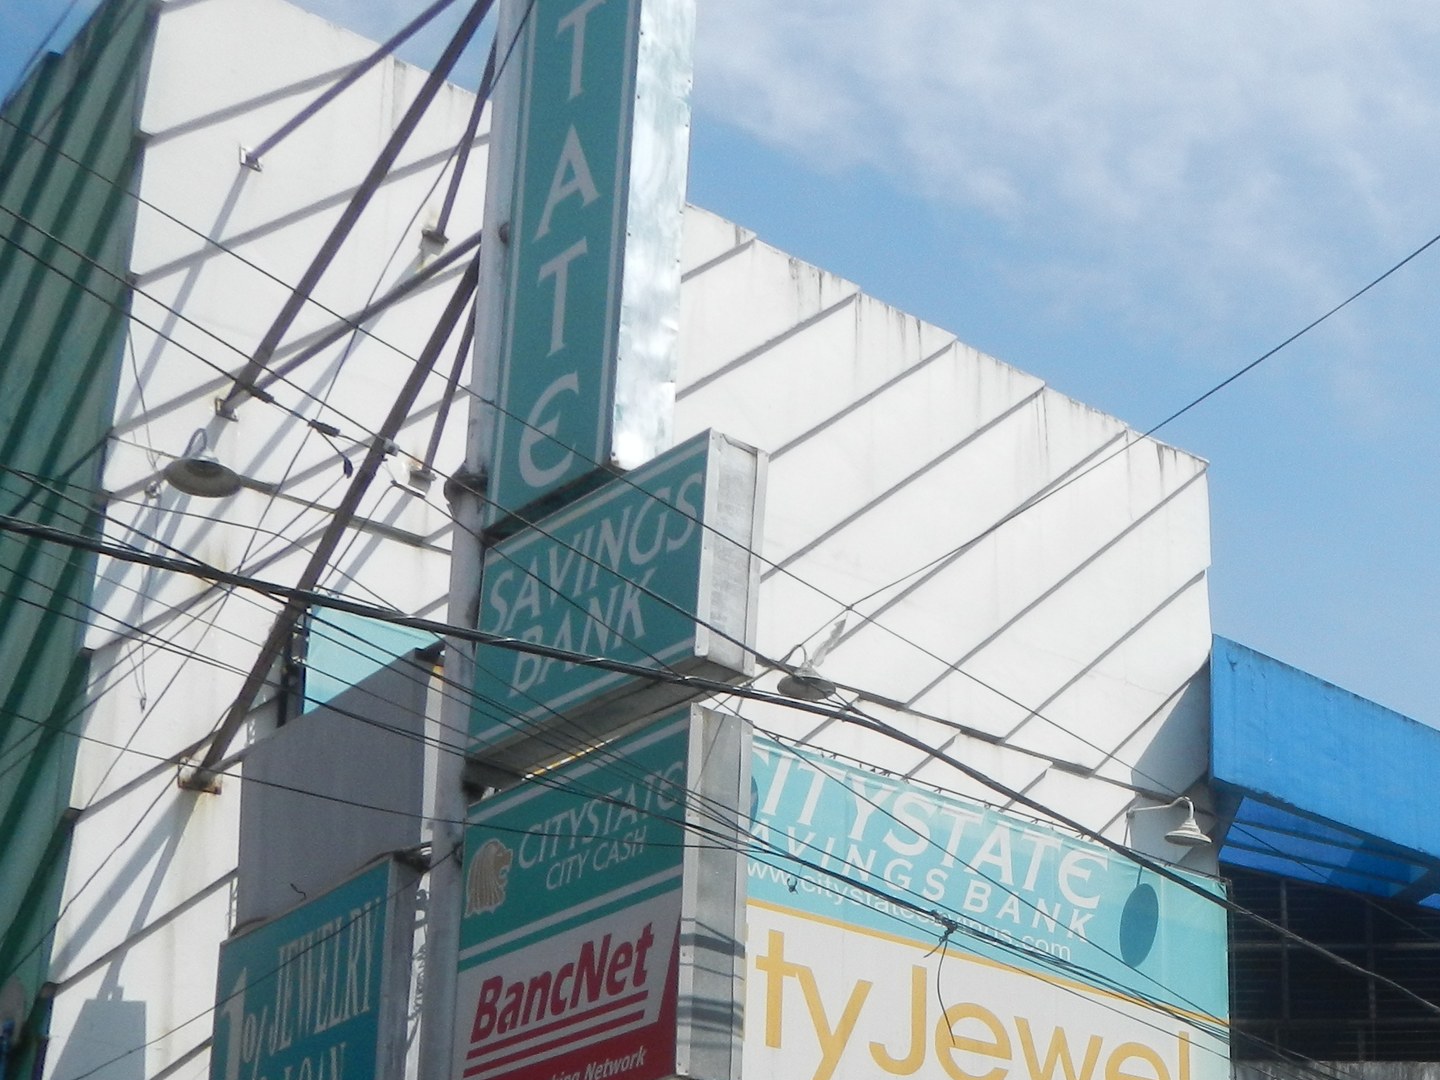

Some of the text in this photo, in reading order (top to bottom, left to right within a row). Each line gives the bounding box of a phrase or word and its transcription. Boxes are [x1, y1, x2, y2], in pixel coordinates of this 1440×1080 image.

[489, 472, 703, 635] SAVINGS
[508, 568, 657, 698] BANK
[546, 825, 647, 891] CITY CASH
[750, 818, 1095, 943] AVINGS BANK
[752, 744, 1109, 909] ITYSTATE
[269, 896, 381, 1056] JEWELRY
[470, 922, 655, 1044] BancNet
